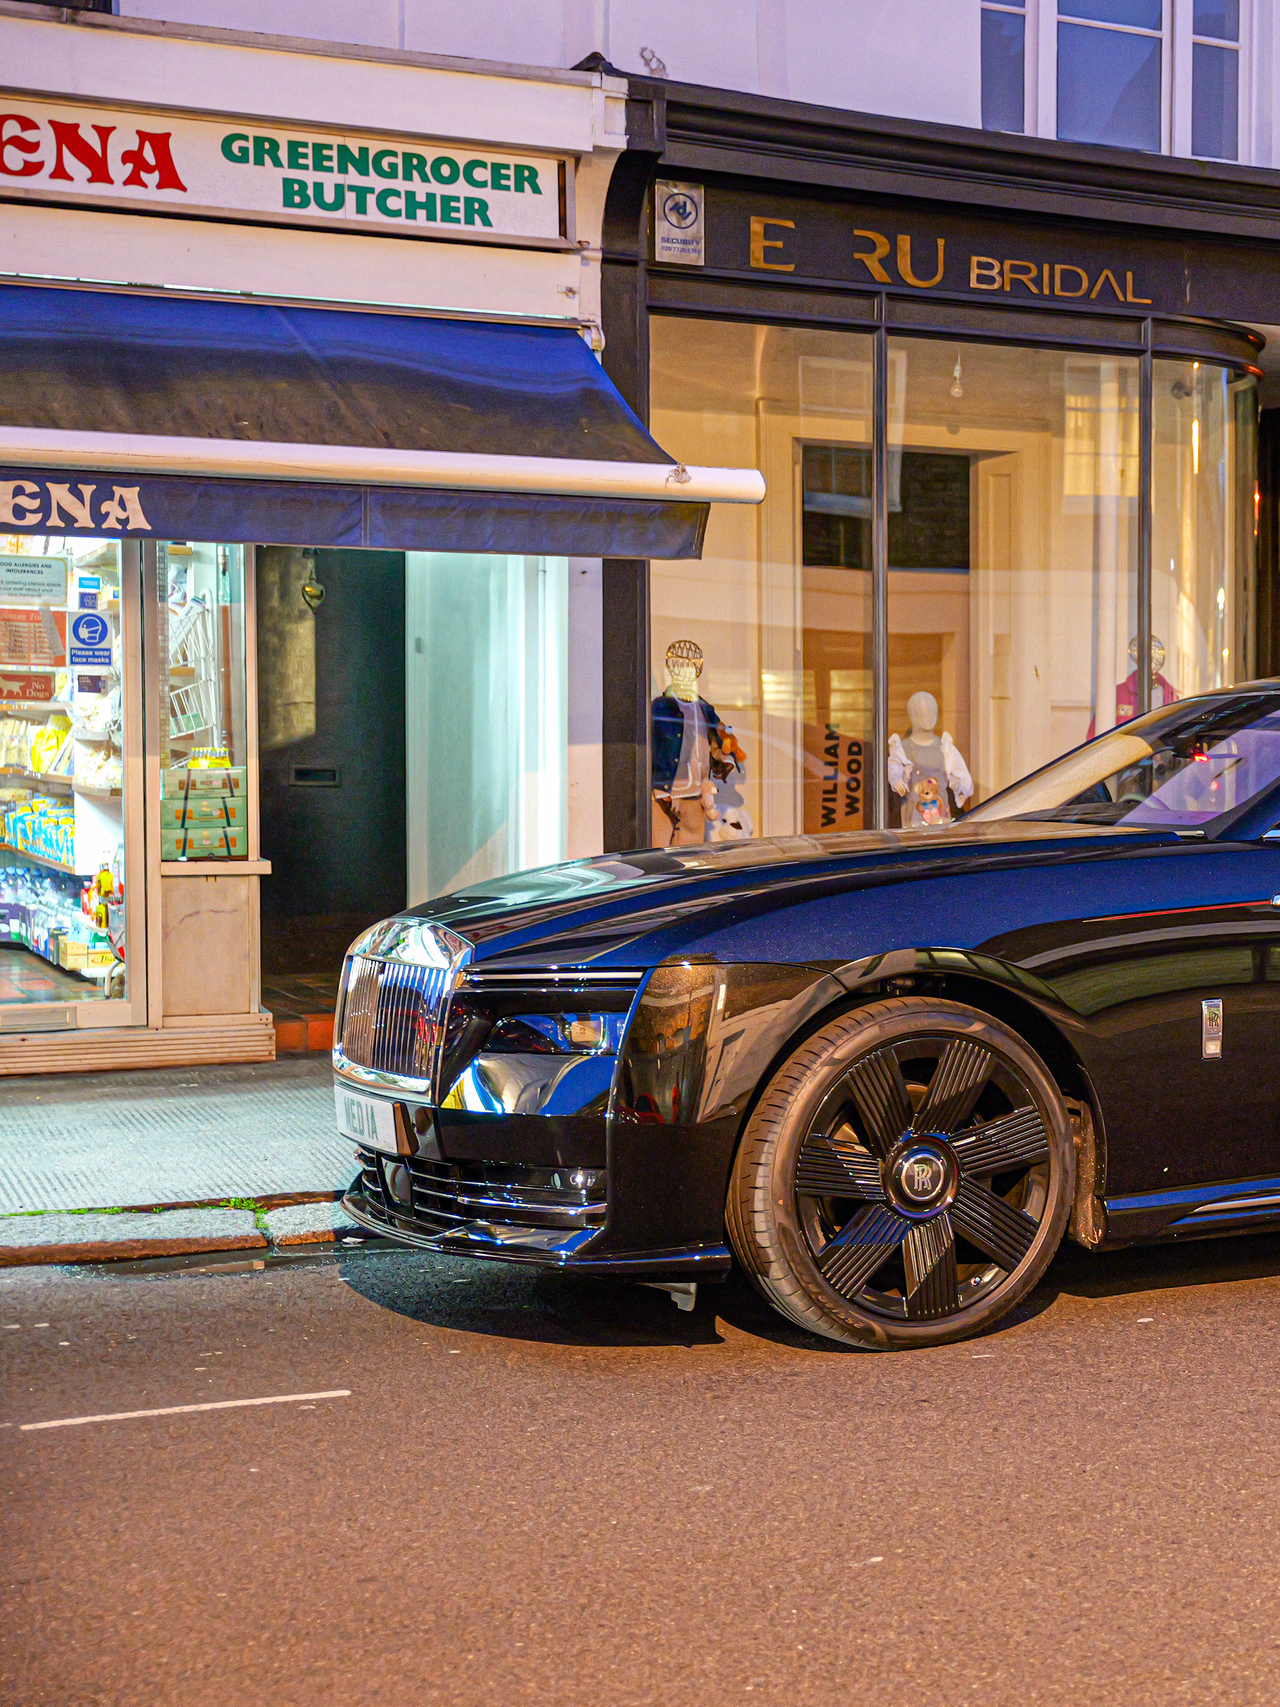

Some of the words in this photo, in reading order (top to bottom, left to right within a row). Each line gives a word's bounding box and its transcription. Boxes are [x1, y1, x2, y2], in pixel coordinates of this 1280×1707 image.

[221, 133, 543, 195] GREENGROCER
[282, 177, 493, 227] BUTCHER
[661, 236, 701, 246] SECURITY
[969, 255, 1153, 304] BRIDAL
[26, 689, 50, 698] Dogs
[31, 681, 44, 690] No
[821, 723, 840, 828] WILLIAM
[845, 741, 863, 817] WOOD
